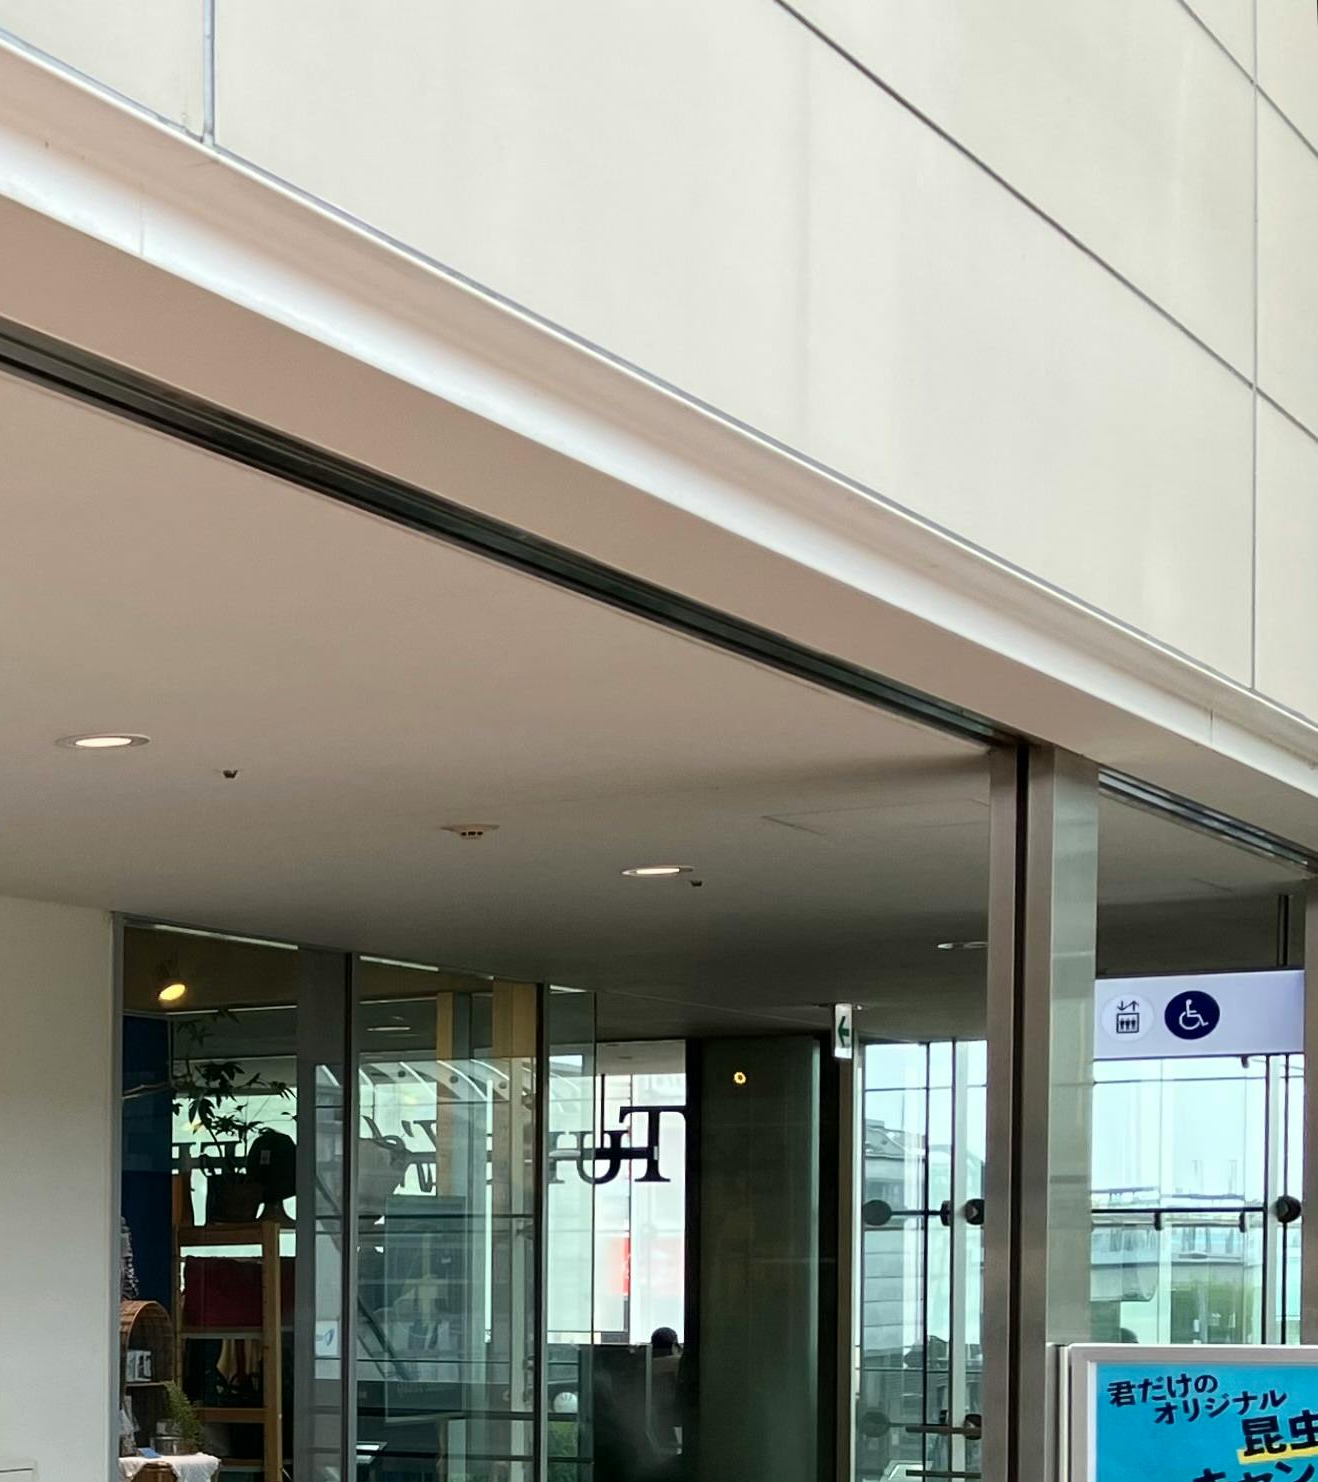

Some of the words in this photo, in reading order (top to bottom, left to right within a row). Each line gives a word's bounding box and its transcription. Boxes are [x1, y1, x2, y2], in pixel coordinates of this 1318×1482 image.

[1107, 1373, 1219, 1408] 君だけの
[1154, 1389, 1288, 1425] オリジナル
